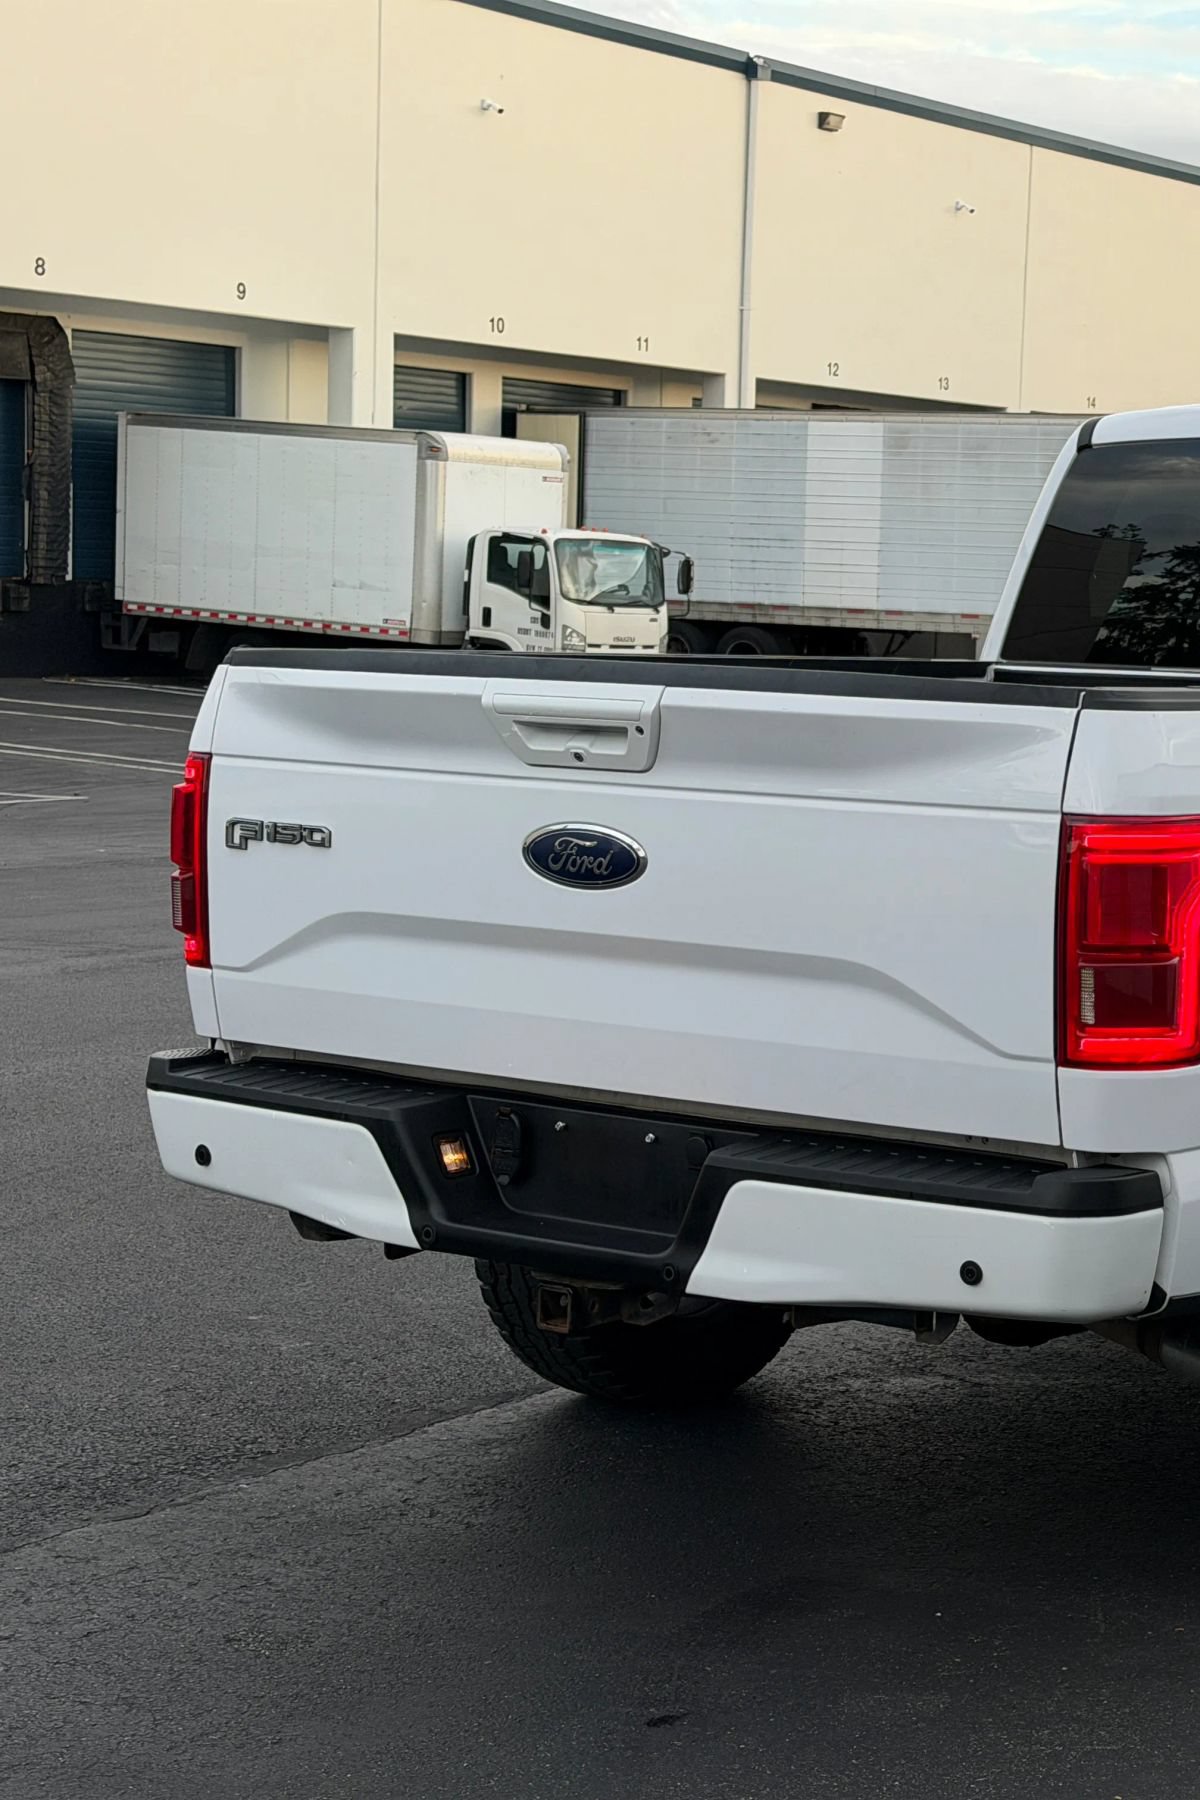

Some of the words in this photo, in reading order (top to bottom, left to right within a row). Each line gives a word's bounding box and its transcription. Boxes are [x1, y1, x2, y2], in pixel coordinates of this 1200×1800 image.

[34, 256, 46, 276] 8
[236, 281, 247, 300] 9
[488, 316, 505, 334] 10
[636, 336, 649, 352] 11
[827, 361, 840, 377] 12
[938, 376, 950, 391] 13
[1086, 396, 1097, 409] 14
[547, 836, 614, 876] Ford
